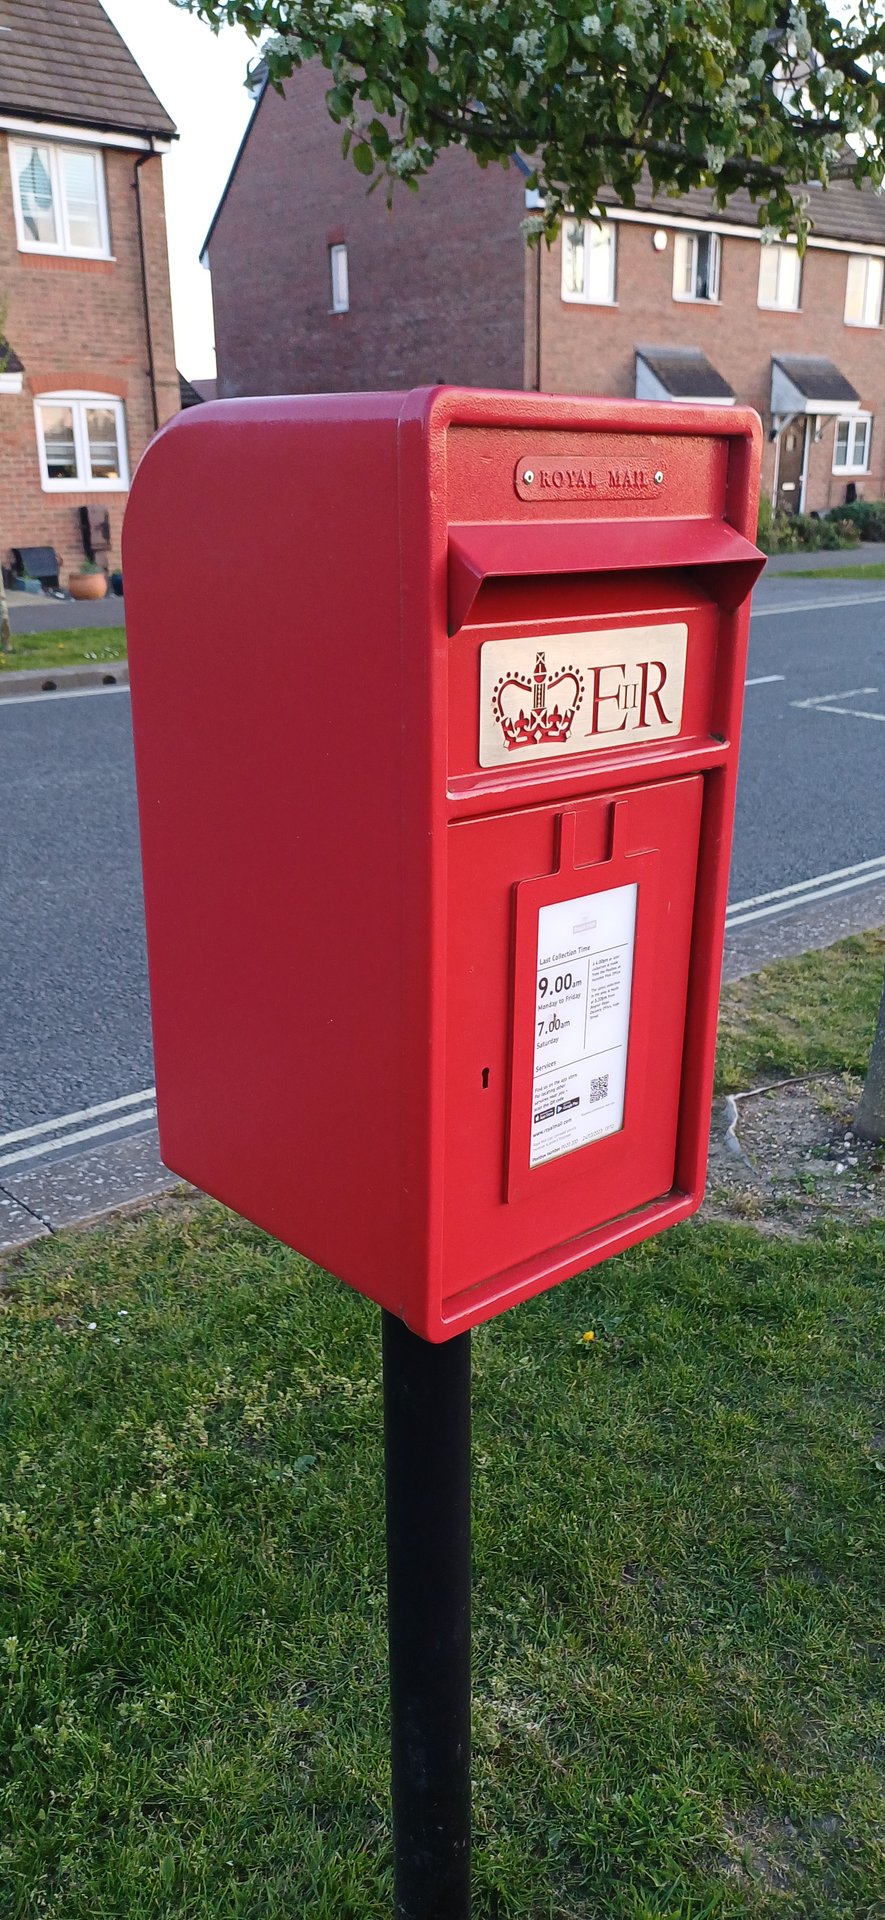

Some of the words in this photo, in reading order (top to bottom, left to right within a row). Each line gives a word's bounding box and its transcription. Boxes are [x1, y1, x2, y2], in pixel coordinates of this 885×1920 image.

[540, 469, 597, 488] ROYAL
[608, 470, 649, 488] MAIL
[539, 957, 551, 965] Last
[552, 949, 577, 962] Collection
[578, 945, 591, 954] Time
[538, 972, 582, 999] 9.00am
[538, 1000, 558, 1011] Monday
[565, 992, 581, 1003] Friday
[537, 1018, 570, 1037] 7.00am
[536, 1037, 559, 1050] Saturday
[535, 1060, 556, 1073] Services
